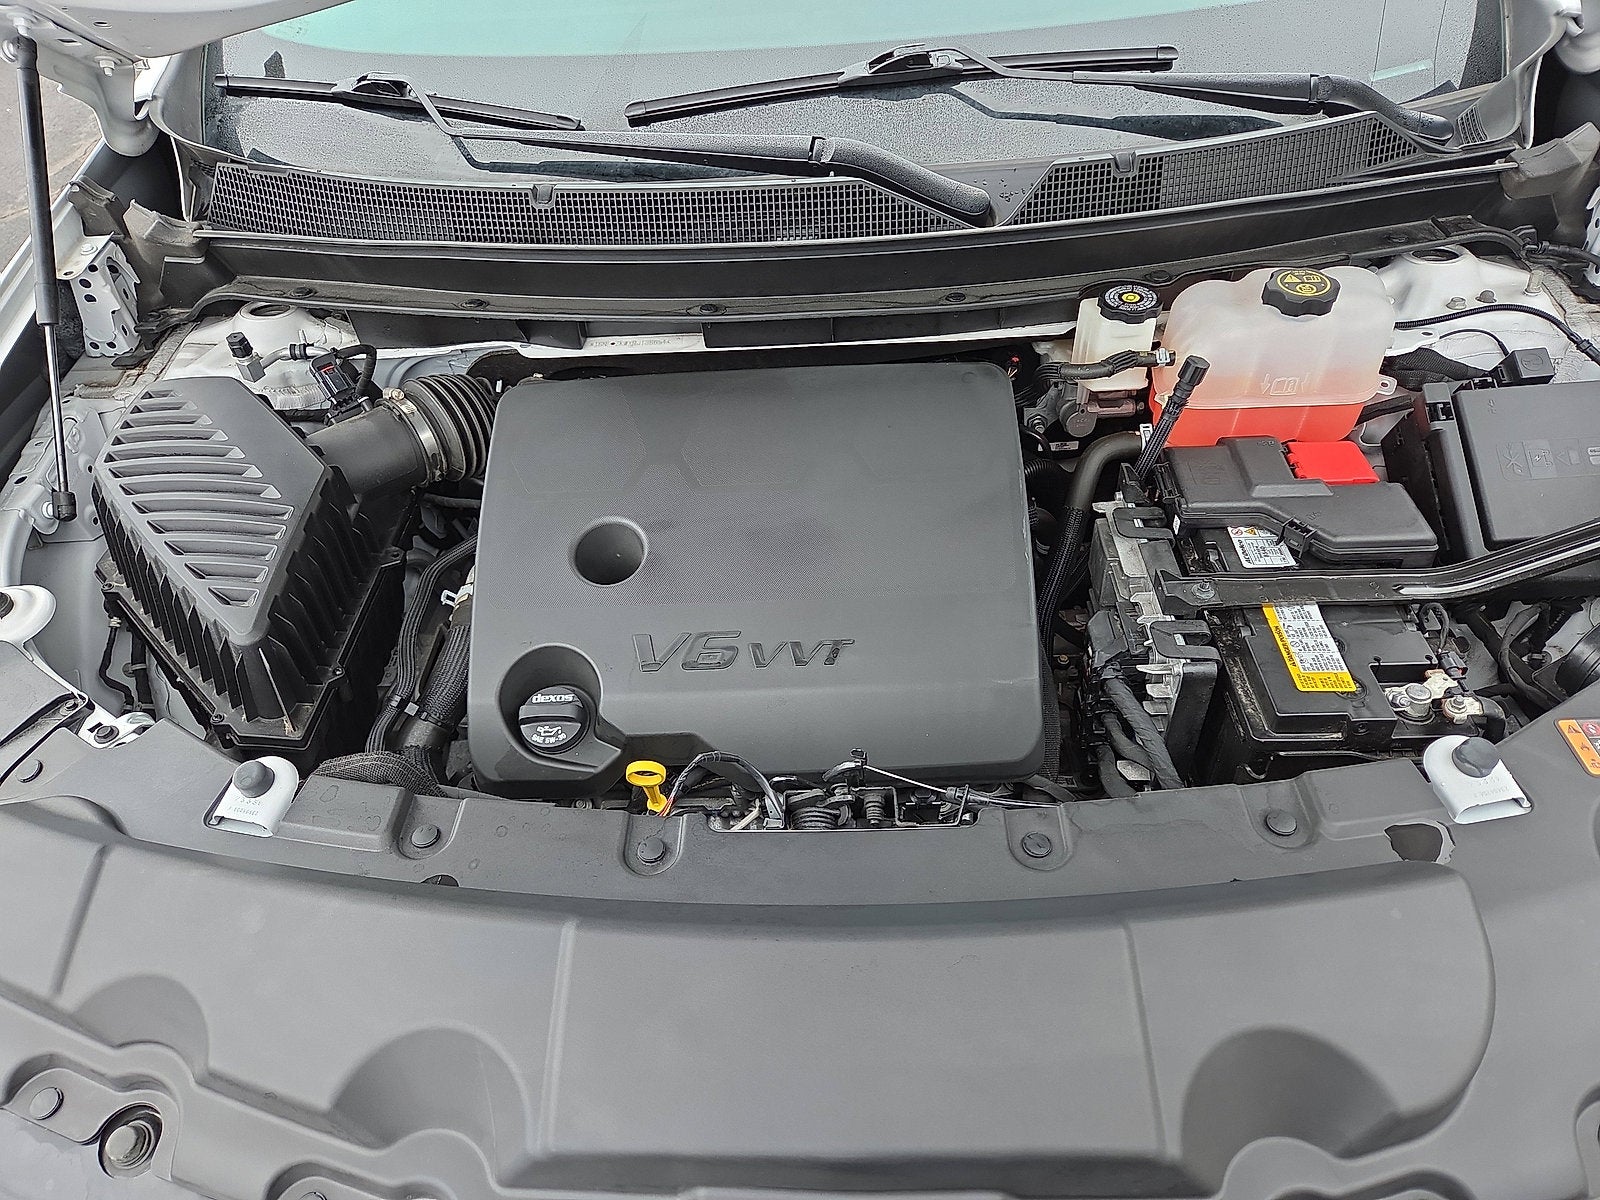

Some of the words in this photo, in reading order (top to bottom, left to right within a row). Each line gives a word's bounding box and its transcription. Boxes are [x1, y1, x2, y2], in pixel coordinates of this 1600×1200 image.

[632, 630, 742, 673] V6
[748, 638, 856, 669] VVT
[531, 693, 575, 704] dexos
